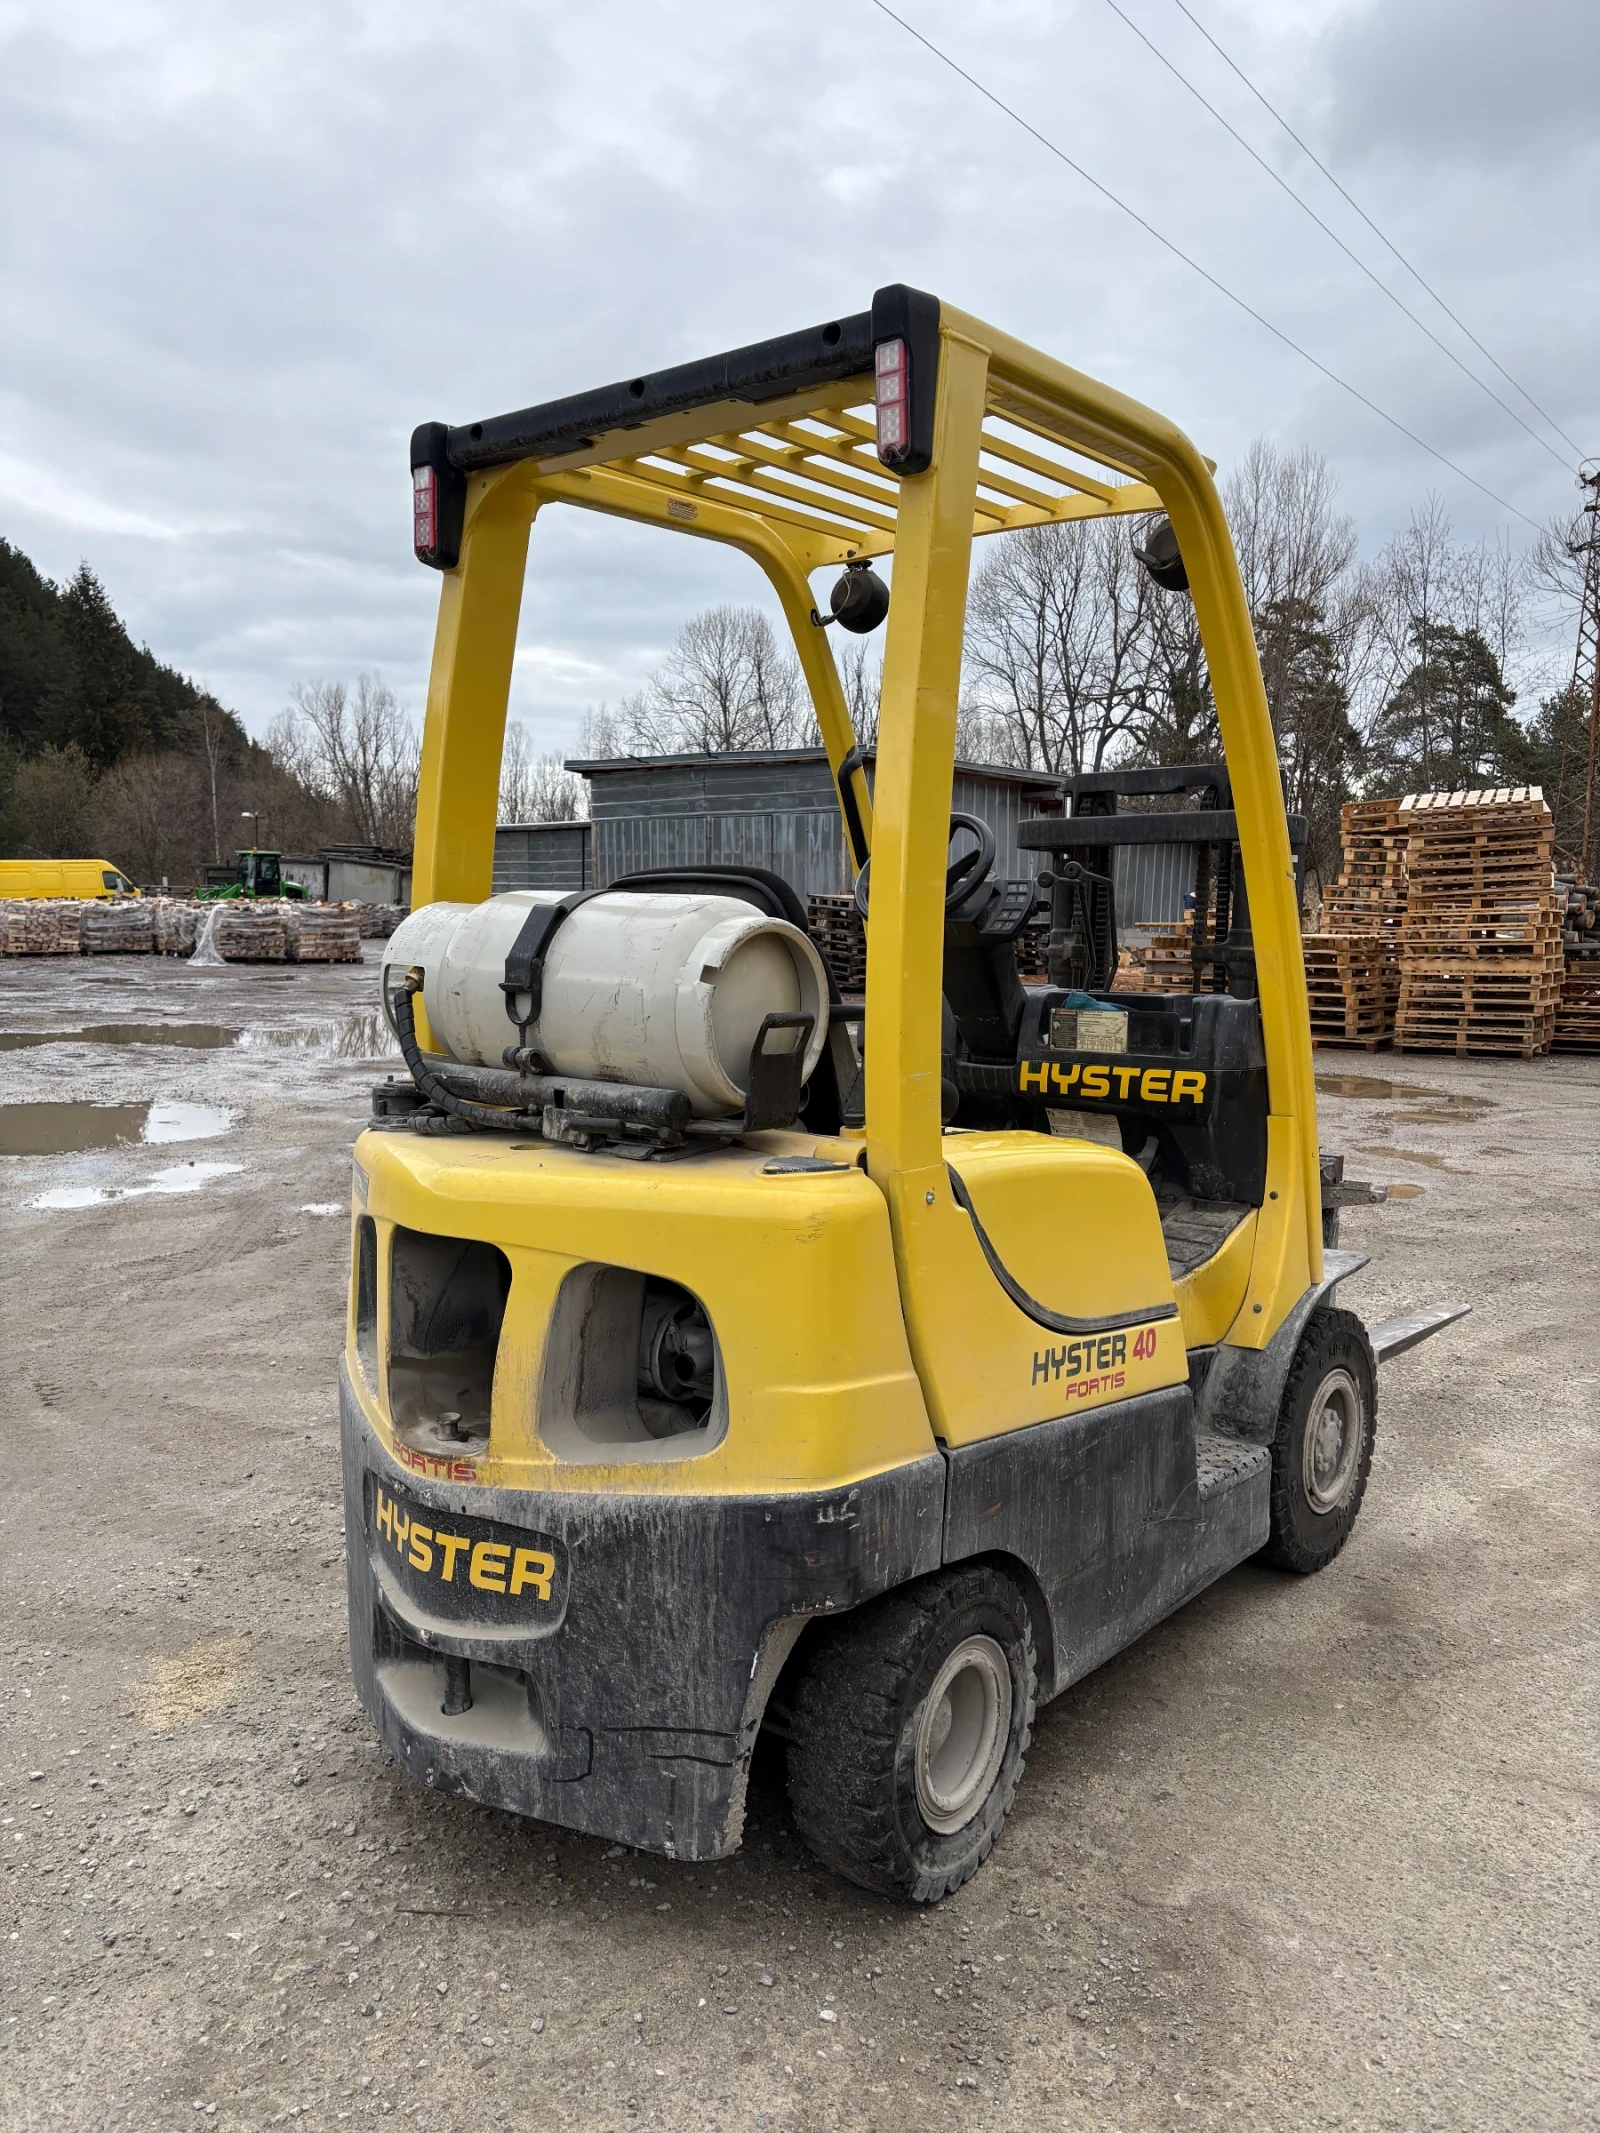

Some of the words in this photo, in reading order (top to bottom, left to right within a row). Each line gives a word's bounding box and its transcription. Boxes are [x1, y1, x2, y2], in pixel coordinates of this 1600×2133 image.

[1019, 1060, 1207, 1103] HYSTER
[1031, 1333, 1127, 1386] HYSTER
[1132, 1328, 1157, 1360] 40
[1065, 1371, 1125, 1400] FORTIS
[392, 1439, 477, 1482] FORTIS
[376, 1488, 556, 1601] HYSTER
